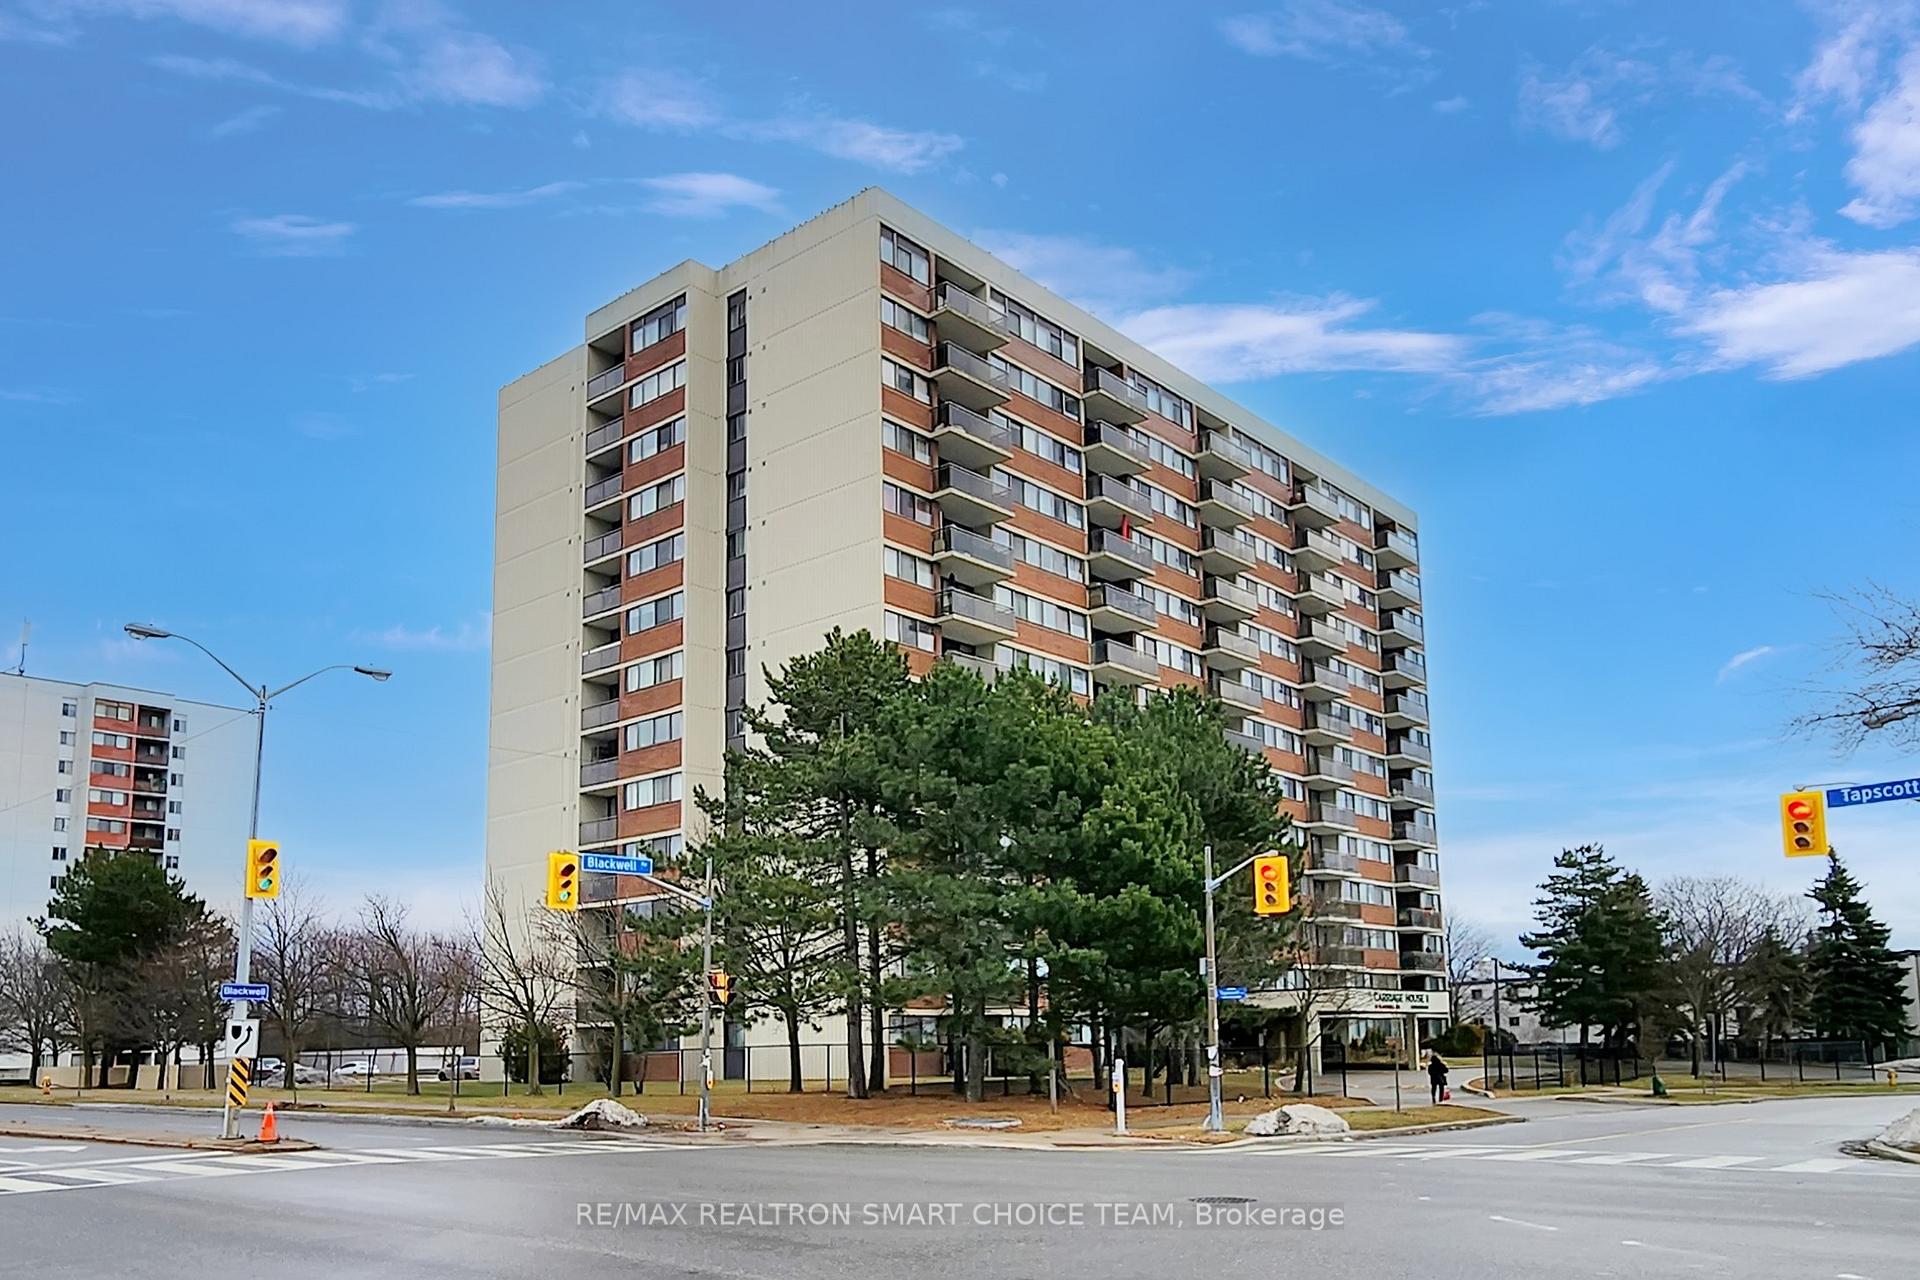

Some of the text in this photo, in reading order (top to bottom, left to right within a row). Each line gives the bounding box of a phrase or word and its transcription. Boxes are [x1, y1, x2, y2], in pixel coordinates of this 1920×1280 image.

[1841, 780, 1920, 803] Tapscott
[587, 856, 637, 872] Blackwell
[223, 986, 266, 996] Blackwell
